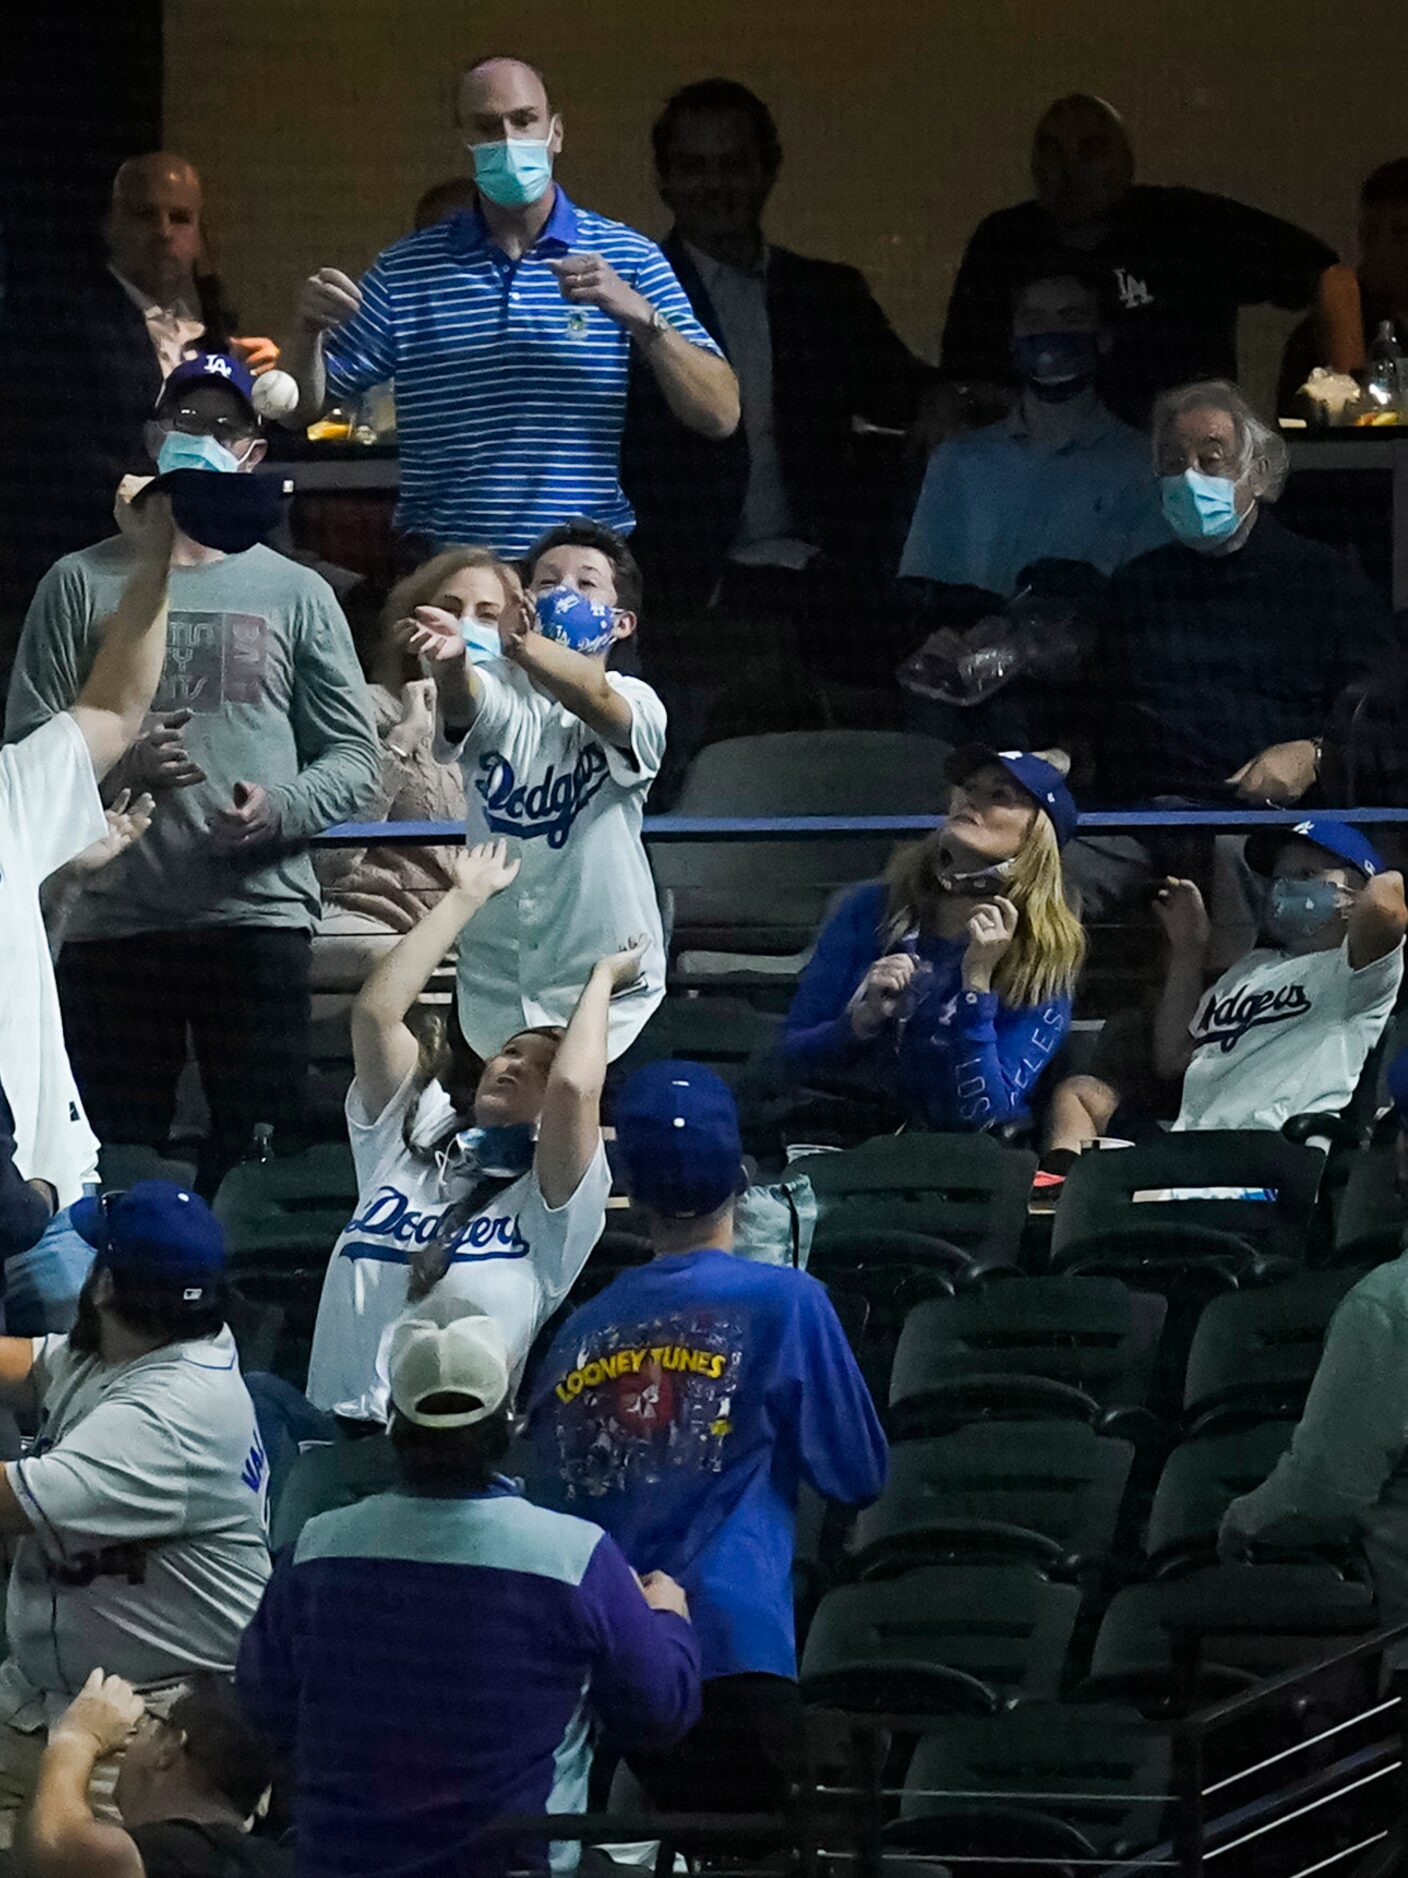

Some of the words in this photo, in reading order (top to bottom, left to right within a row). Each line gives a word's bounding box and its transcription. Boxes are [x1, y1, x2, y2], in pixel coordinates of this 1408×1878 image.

[1112, 266, 1155, 309] LA
[203, 353, 232, 379] LA
[555, 1347, 648, 1405] LOONEY
[650, 1345, 727, 1379] TUNES
